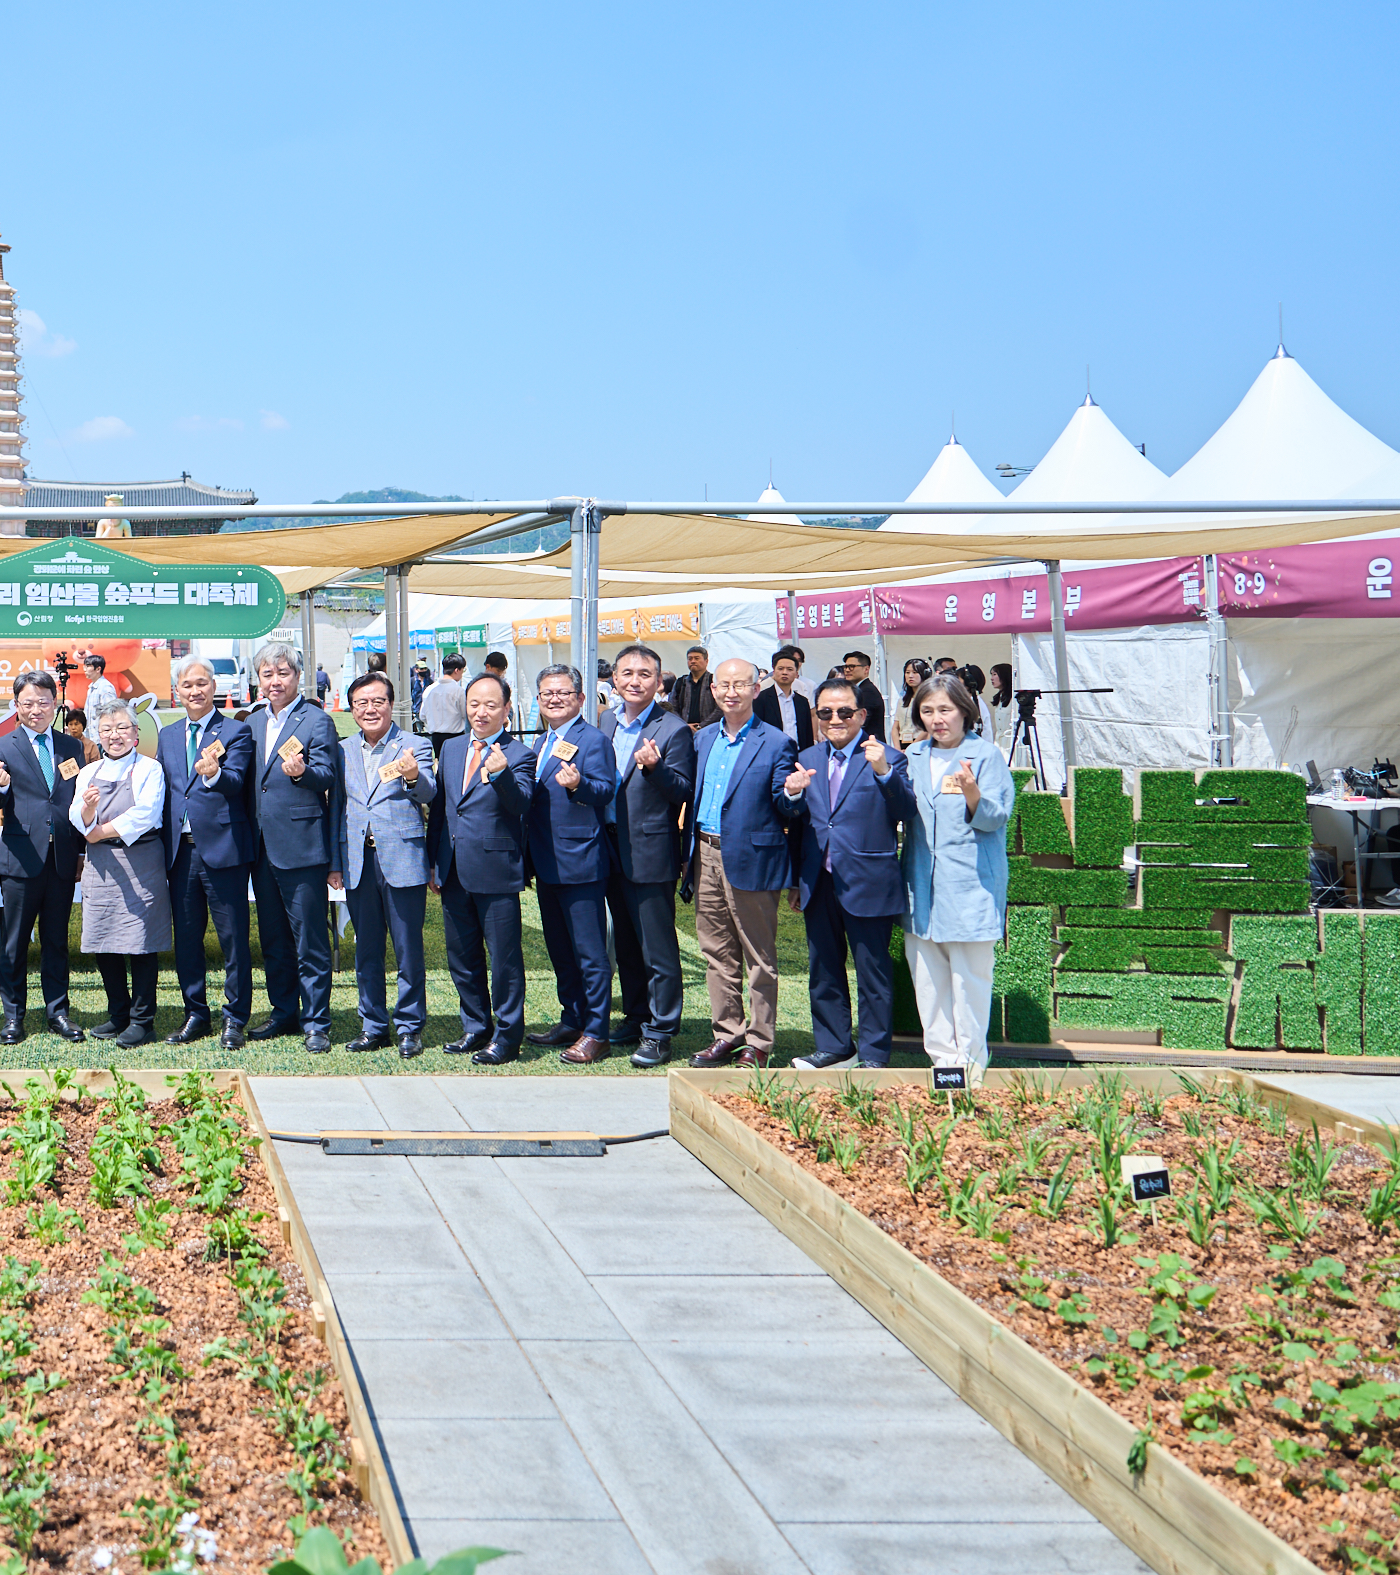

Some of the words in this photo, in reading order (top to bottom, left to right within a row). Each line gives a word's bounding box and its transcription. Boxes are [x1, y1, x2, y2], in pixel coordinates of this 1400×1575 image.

[1366, 557, 1393, 599] 운
[24, 582, 100, 607] 임산물
[104, 582, 180, 606] 숲푸드
[184, 582, 259, 607] 대축제
[33, 615, 54, 623] 산림청
[64, 614, 85, 625] Kofpi
[86, 615, 125, 623] 한국임업진흥원
[796, 602, 844, 629] 운영본부
[1004, 766, 1313, 913] 산물
